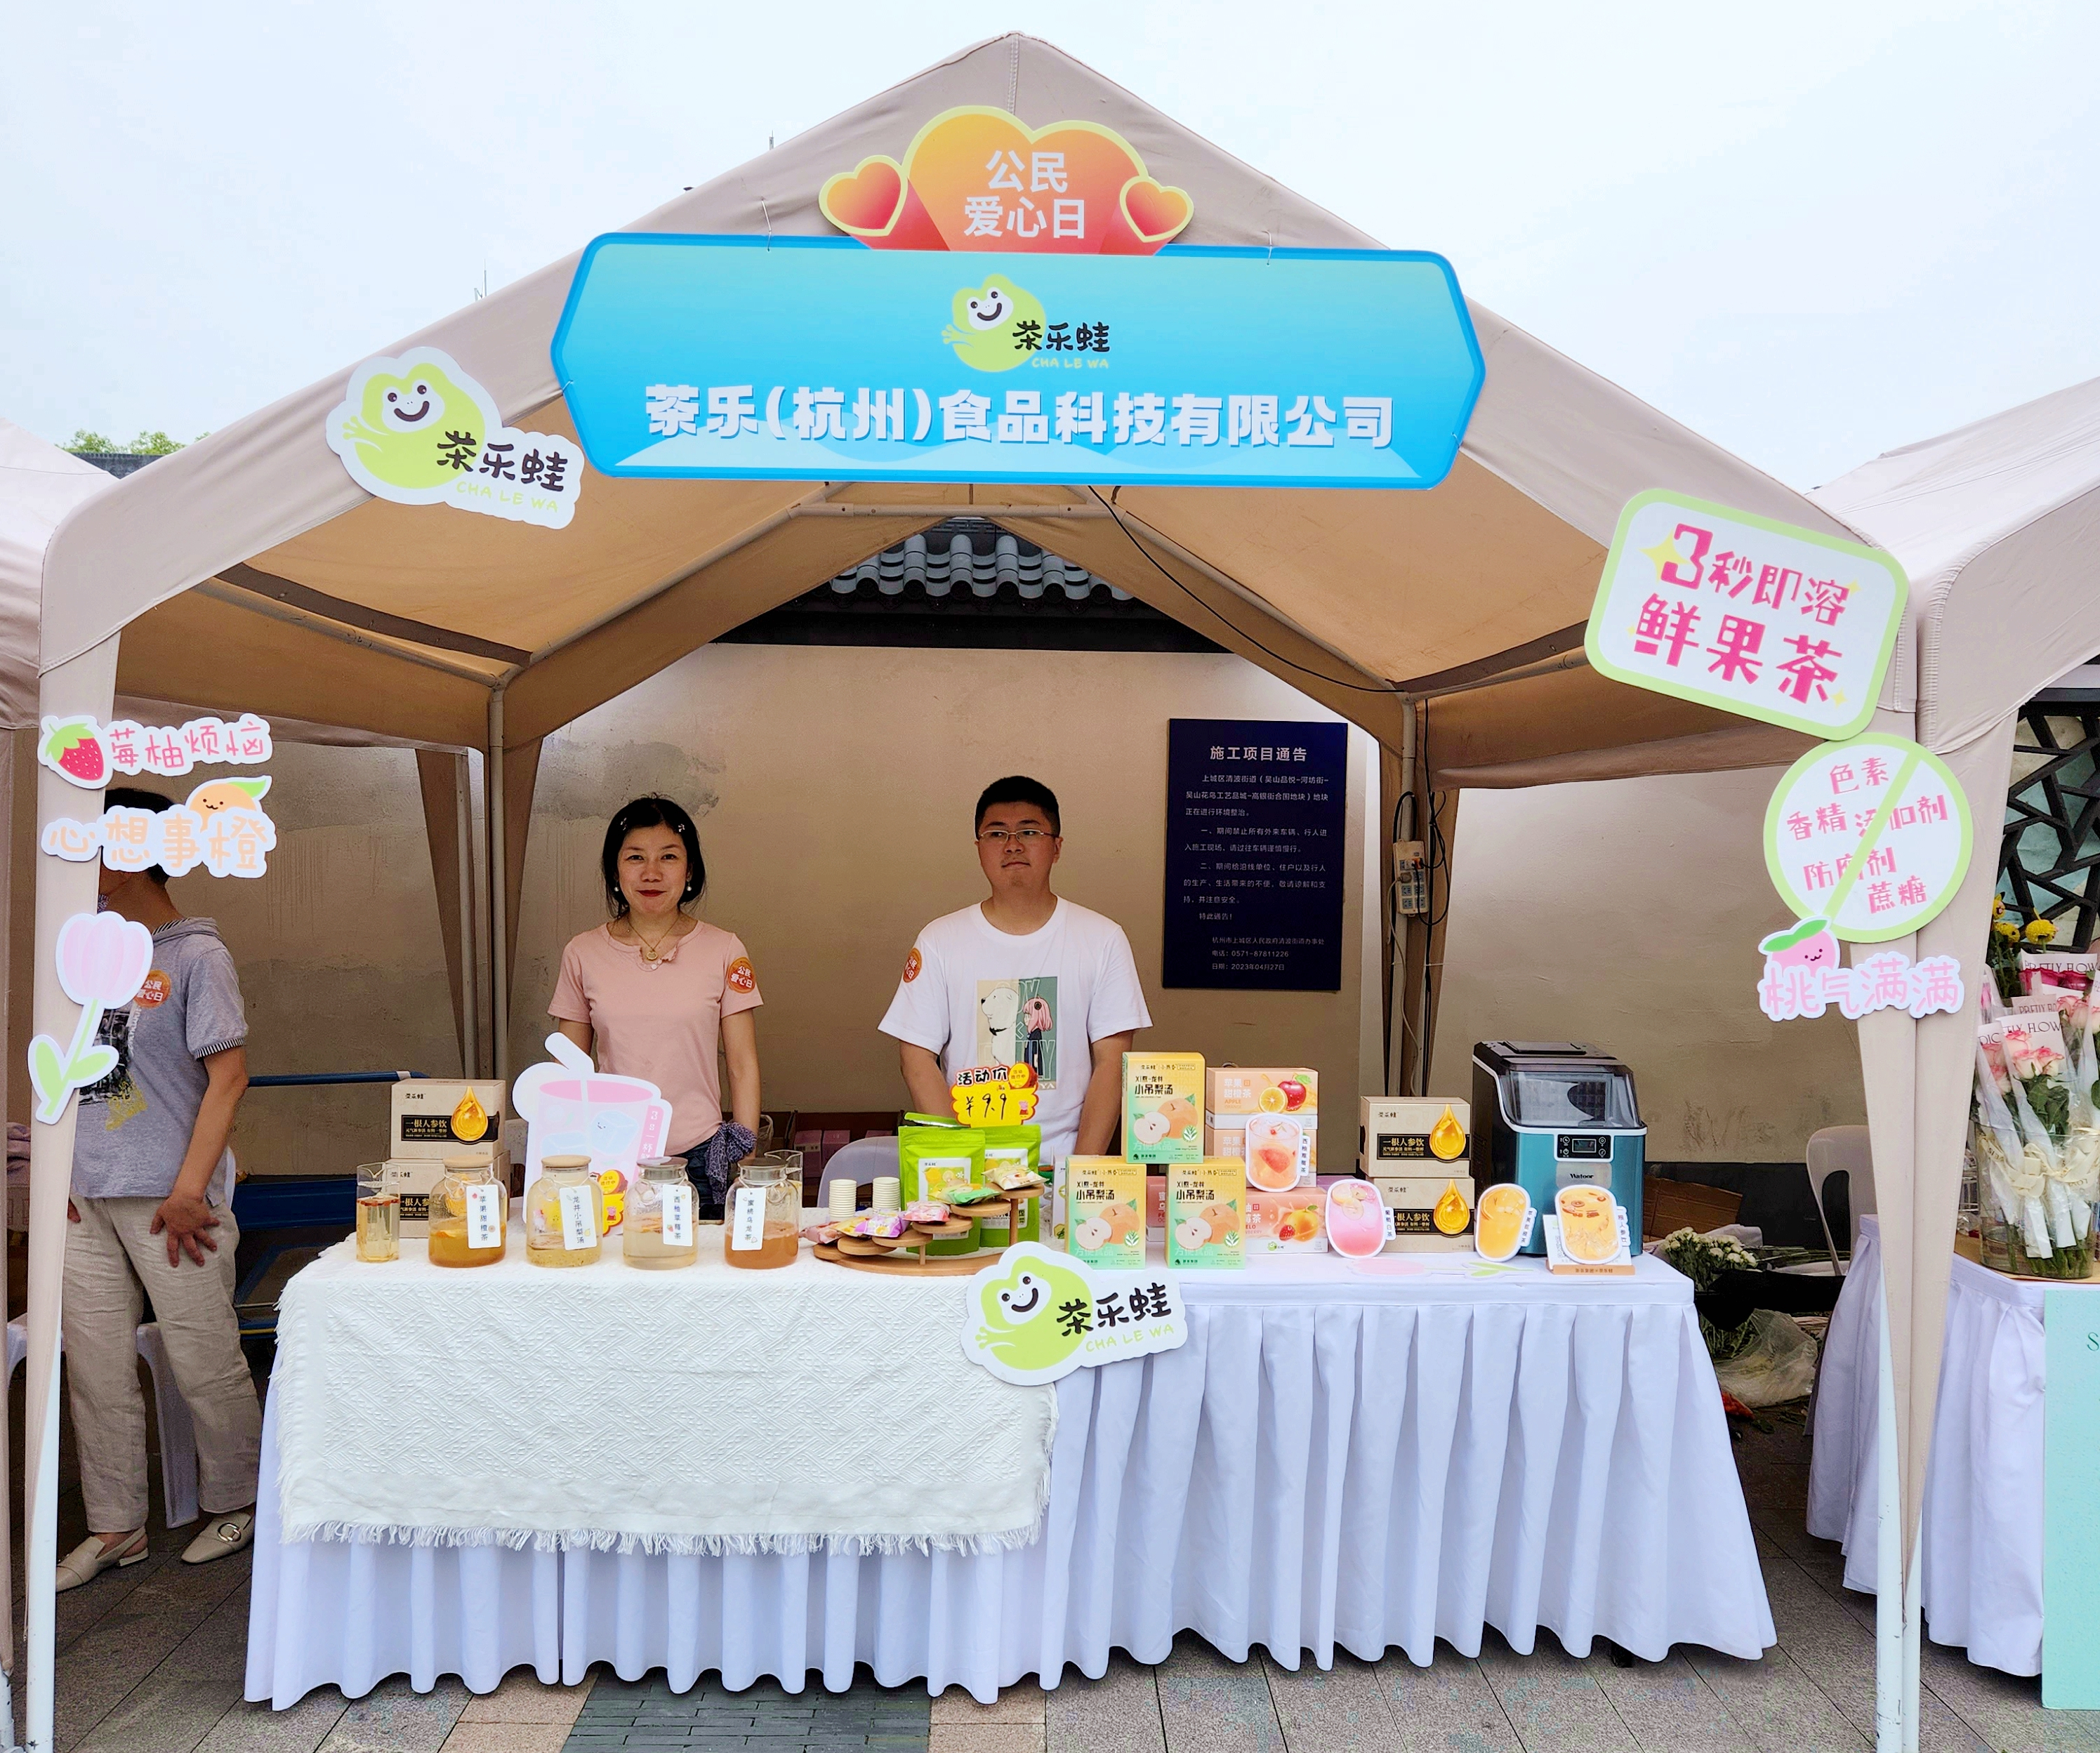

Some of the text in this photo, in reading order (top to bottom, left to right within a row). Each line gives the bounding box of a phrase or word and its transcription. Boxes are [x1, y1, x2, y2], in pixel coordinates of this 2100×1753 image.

[985, 150, 1068, 193] 公民
[963, 195, 1085, 239] 爱心日
[1012, 319, 1110, 352] 茶乐蛙
[1031, 357, 1109, 369] CHA LE WA
[645, 383, 1394, 449] 茶乐(杭州)食品科技有限公司
[437, 430, 568, 491] 茶乐蛙
[456, 481, 558, 513] CHA LE WA
[1660, 523, 1850, 627] 3秒即溶
[1633, 593, 1843, 704] 鲜果茶
[109, 720, 264, 769] 莓柚烦恼
[1210, 746, 1308, 762] 施工项目通告
[1829, 757, 1889, 795] 色素
[1786, 802, 1848, 841] 香精
[48, 813, 268, 871] 心想事橙
[1866, 875, 1927, 914] 蔗糖
[143, 979, 163, 991] 公民
[1764, 958, 1959, 1017] 桃气满满
[958, 1067, 1007, 1085] 活动价
[1135, 1083, 1173, 1095] 小吊梨汤
[1224, 1078, 1242, 1087] 苹果
[1224, 1088, 1252, 1099] 甜橙茶
[405, 1118, 447, 1129] 一根人参饮
[1382, 1137, 1425, 1147] 一根人参饮
[1076, 1189, 1115, 1200] 小吊梨汤
[1176, 1189, 1215, 1200] 小吊梨汤
[479, 1195, 489, 1241] 苹果甜橙茶
[744, 1199, 755, 1241] 蜜桃乌龙茶
[1056, 1282, 1172, 1337] 茶乐蛙
[1085, 1323, 1175, 1352] CHA LE WA
